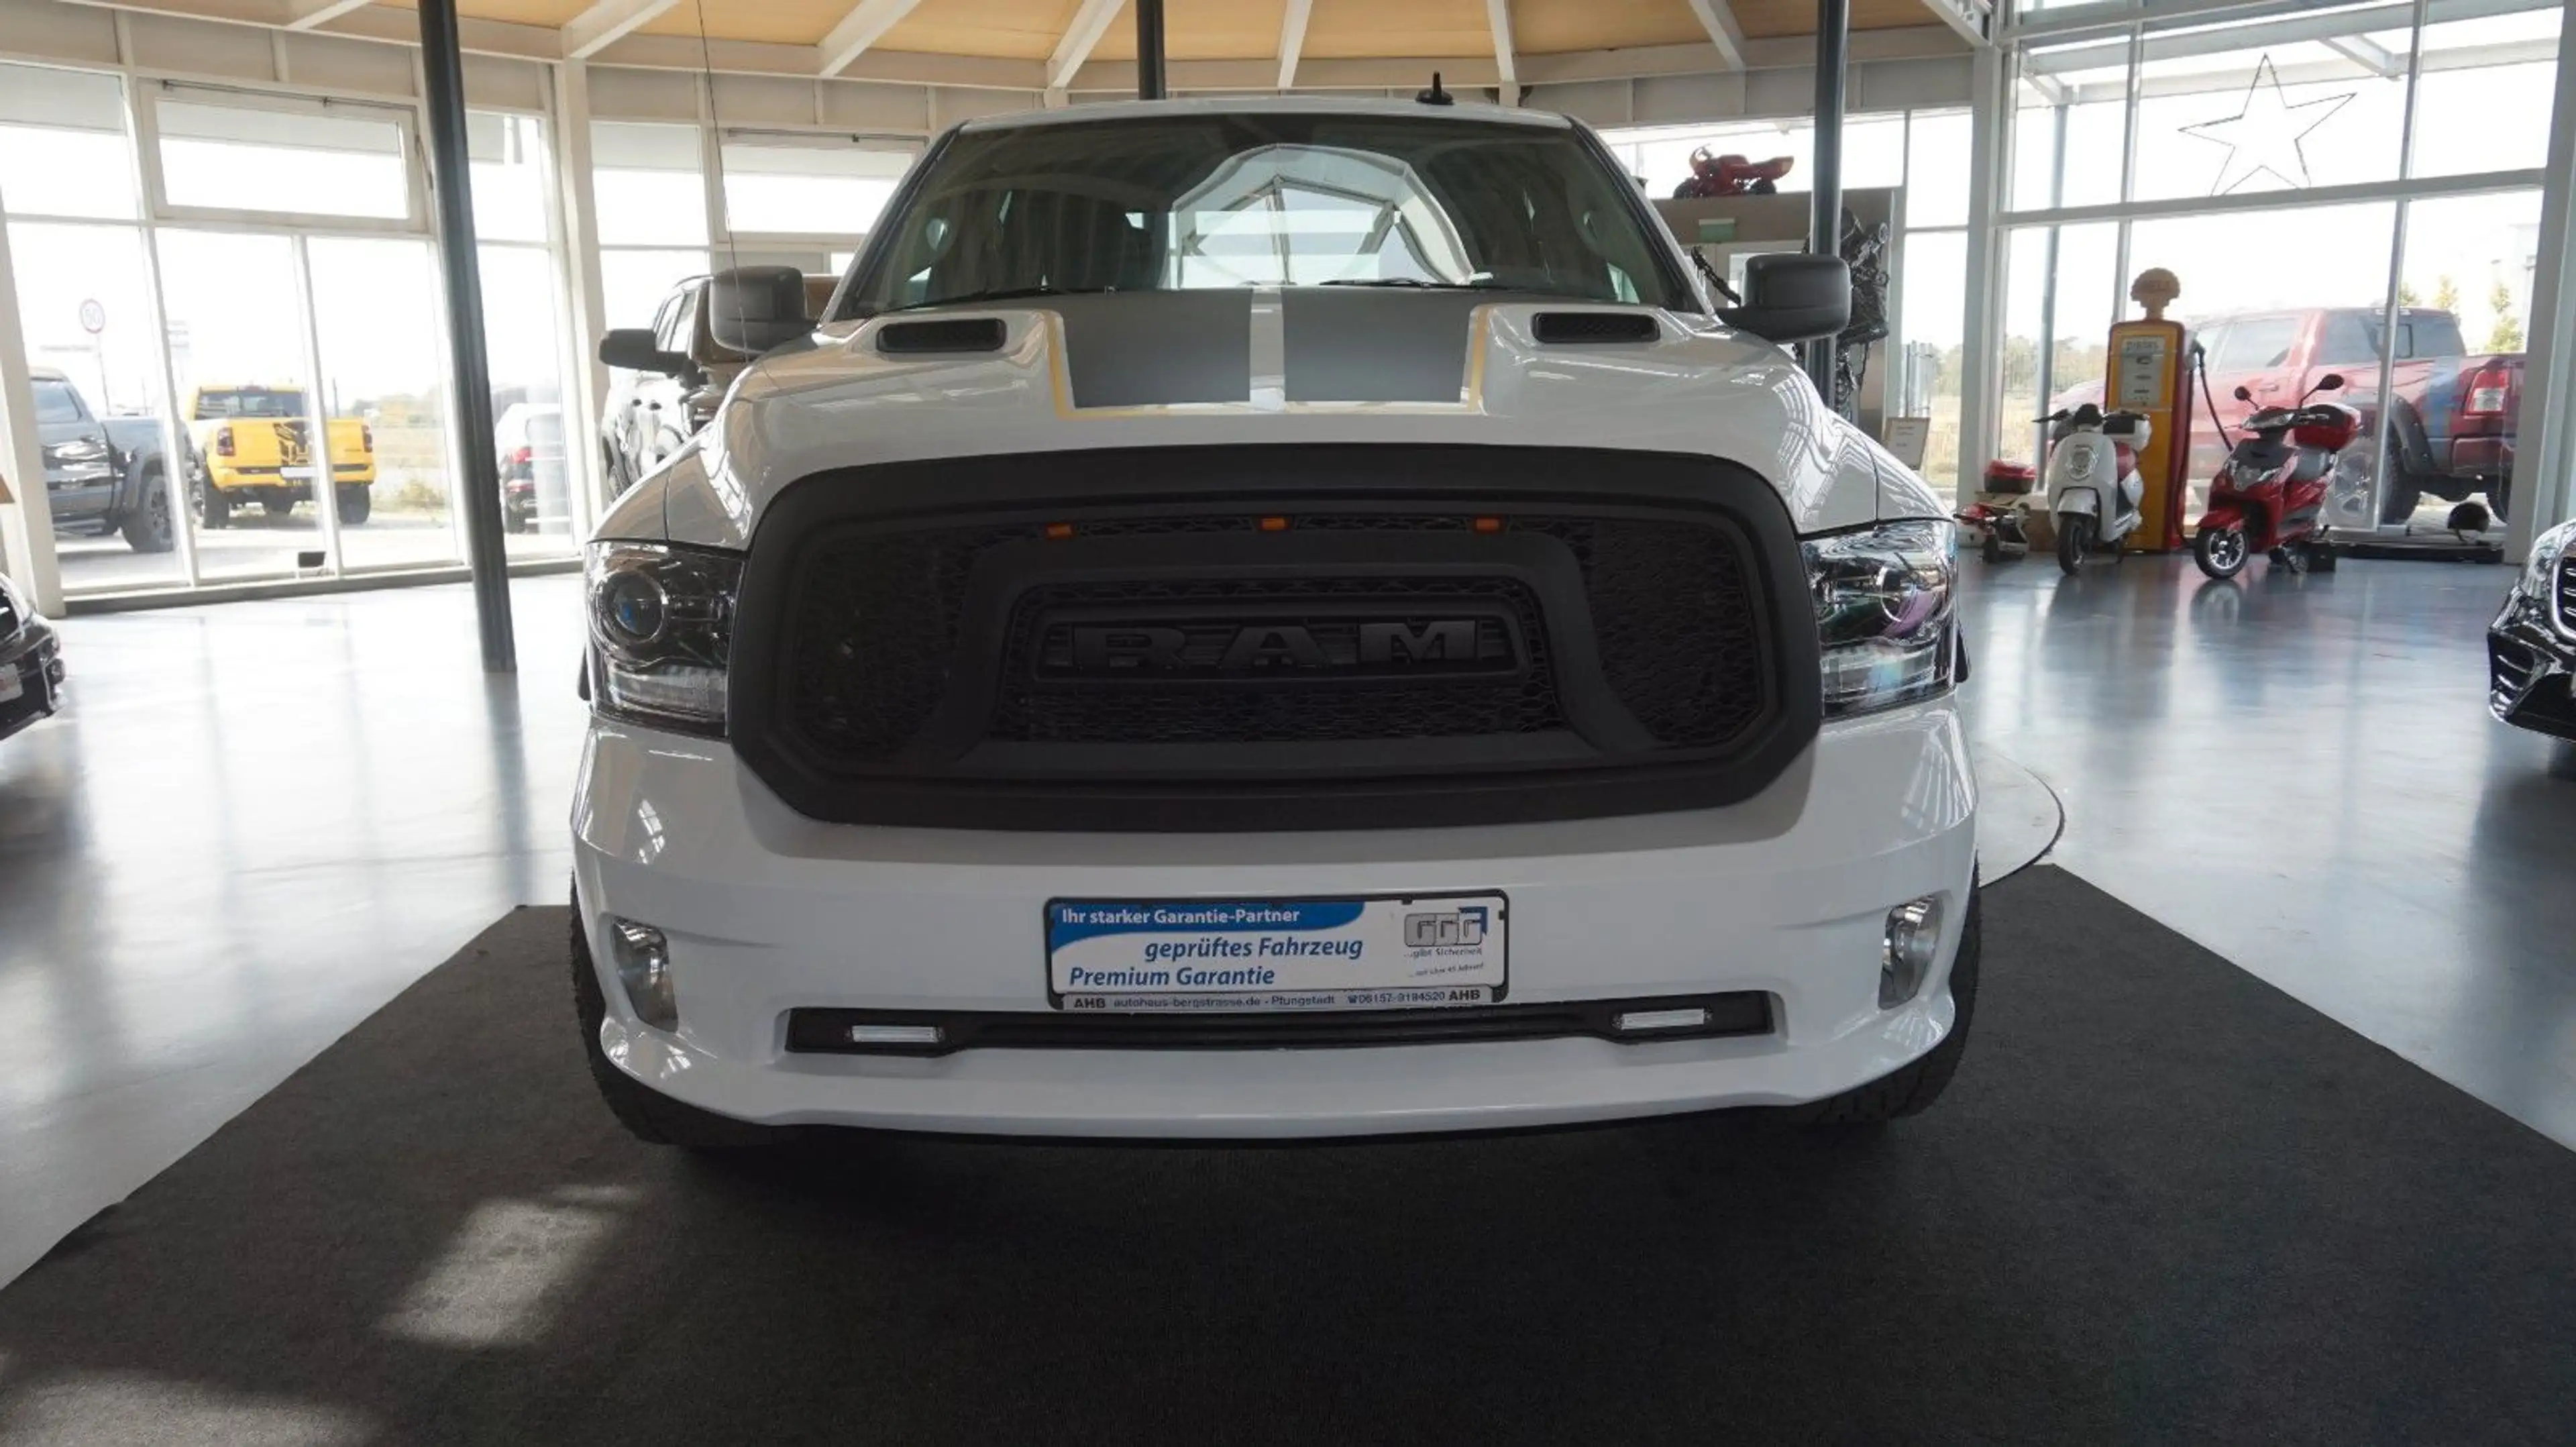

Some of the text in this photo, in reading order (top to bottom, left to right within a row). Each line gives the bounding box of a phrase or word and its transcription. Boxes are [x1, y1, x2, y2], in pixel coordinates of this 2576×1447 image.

[1075, 619, 1476, 669] RAM
[1062, 908, 1300, 924] Ihr starker Garantie-Partner
[1144, 936, 1363, 962] geprüftes Fahrzeug
[1069, 966, 1275, 986] Premium Garantie
[1073, 998, 1106, 1008] AHB
[1448, 989, 1481, 1001] AHB
